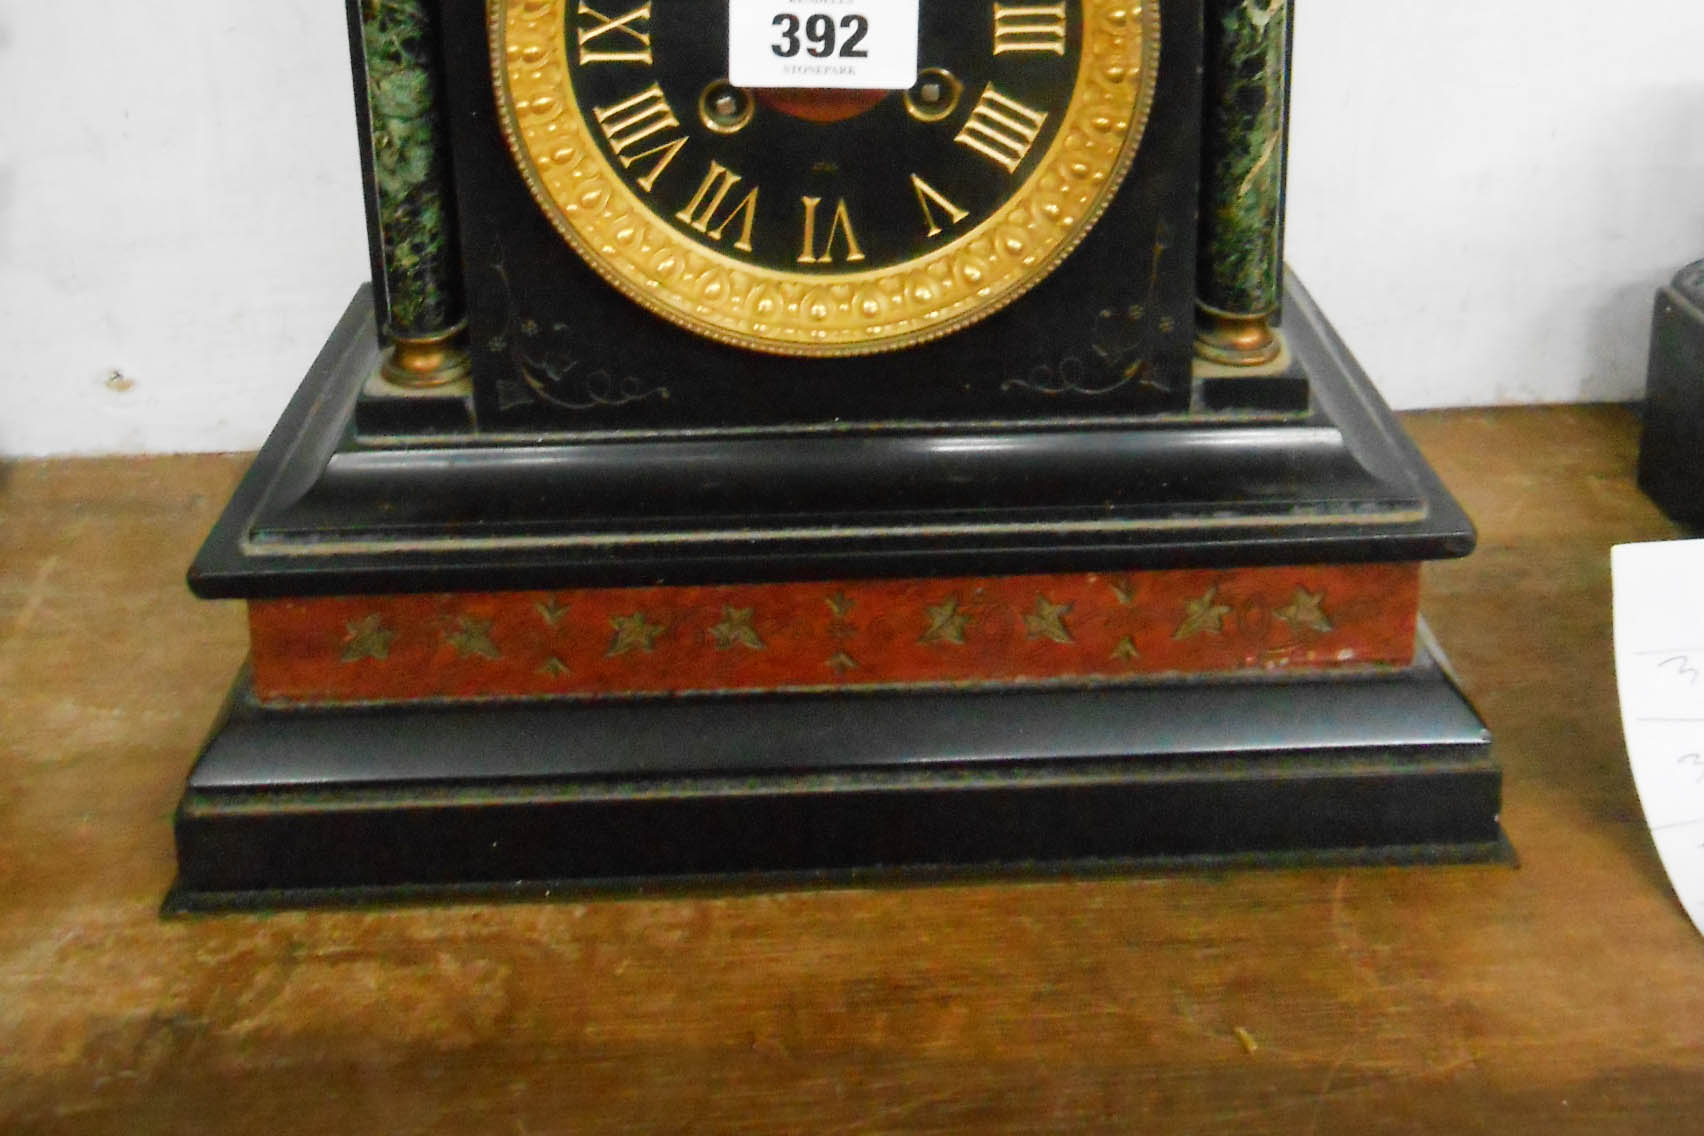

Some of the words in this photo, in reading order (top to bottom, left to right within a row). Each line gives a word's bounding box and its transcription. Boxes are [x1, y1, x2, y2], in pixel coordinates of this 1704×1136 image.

[771, 13, 869, 58] 392
[994, 1, 1067, 56] III
[593, 82, 689, 193] VIII
[955, 81, 1048, 174] IIII
[676, 161, 758, 251] VII
[797, 195, 866, 263] VI
[911, 173, 969, 237] V
